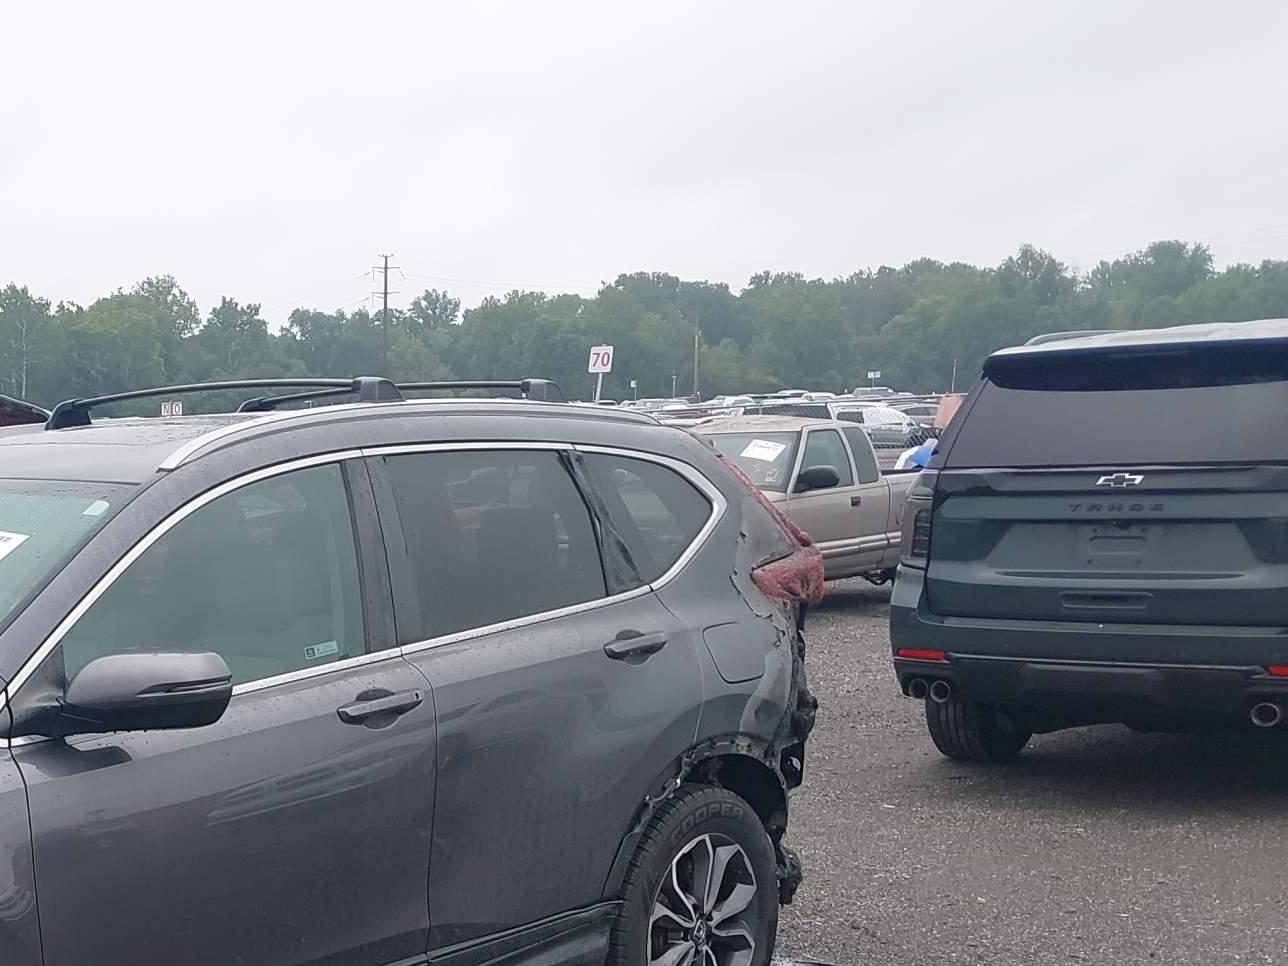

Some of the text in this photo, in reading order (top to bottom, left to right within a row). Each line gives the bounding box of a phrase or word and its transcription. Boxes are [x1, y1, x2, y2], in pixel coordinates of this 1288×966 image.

[592, 352, 611, 367] 70
[1068, 503, 1165, 512] TAHOE
[671, 802, 744, 839] COOPER
